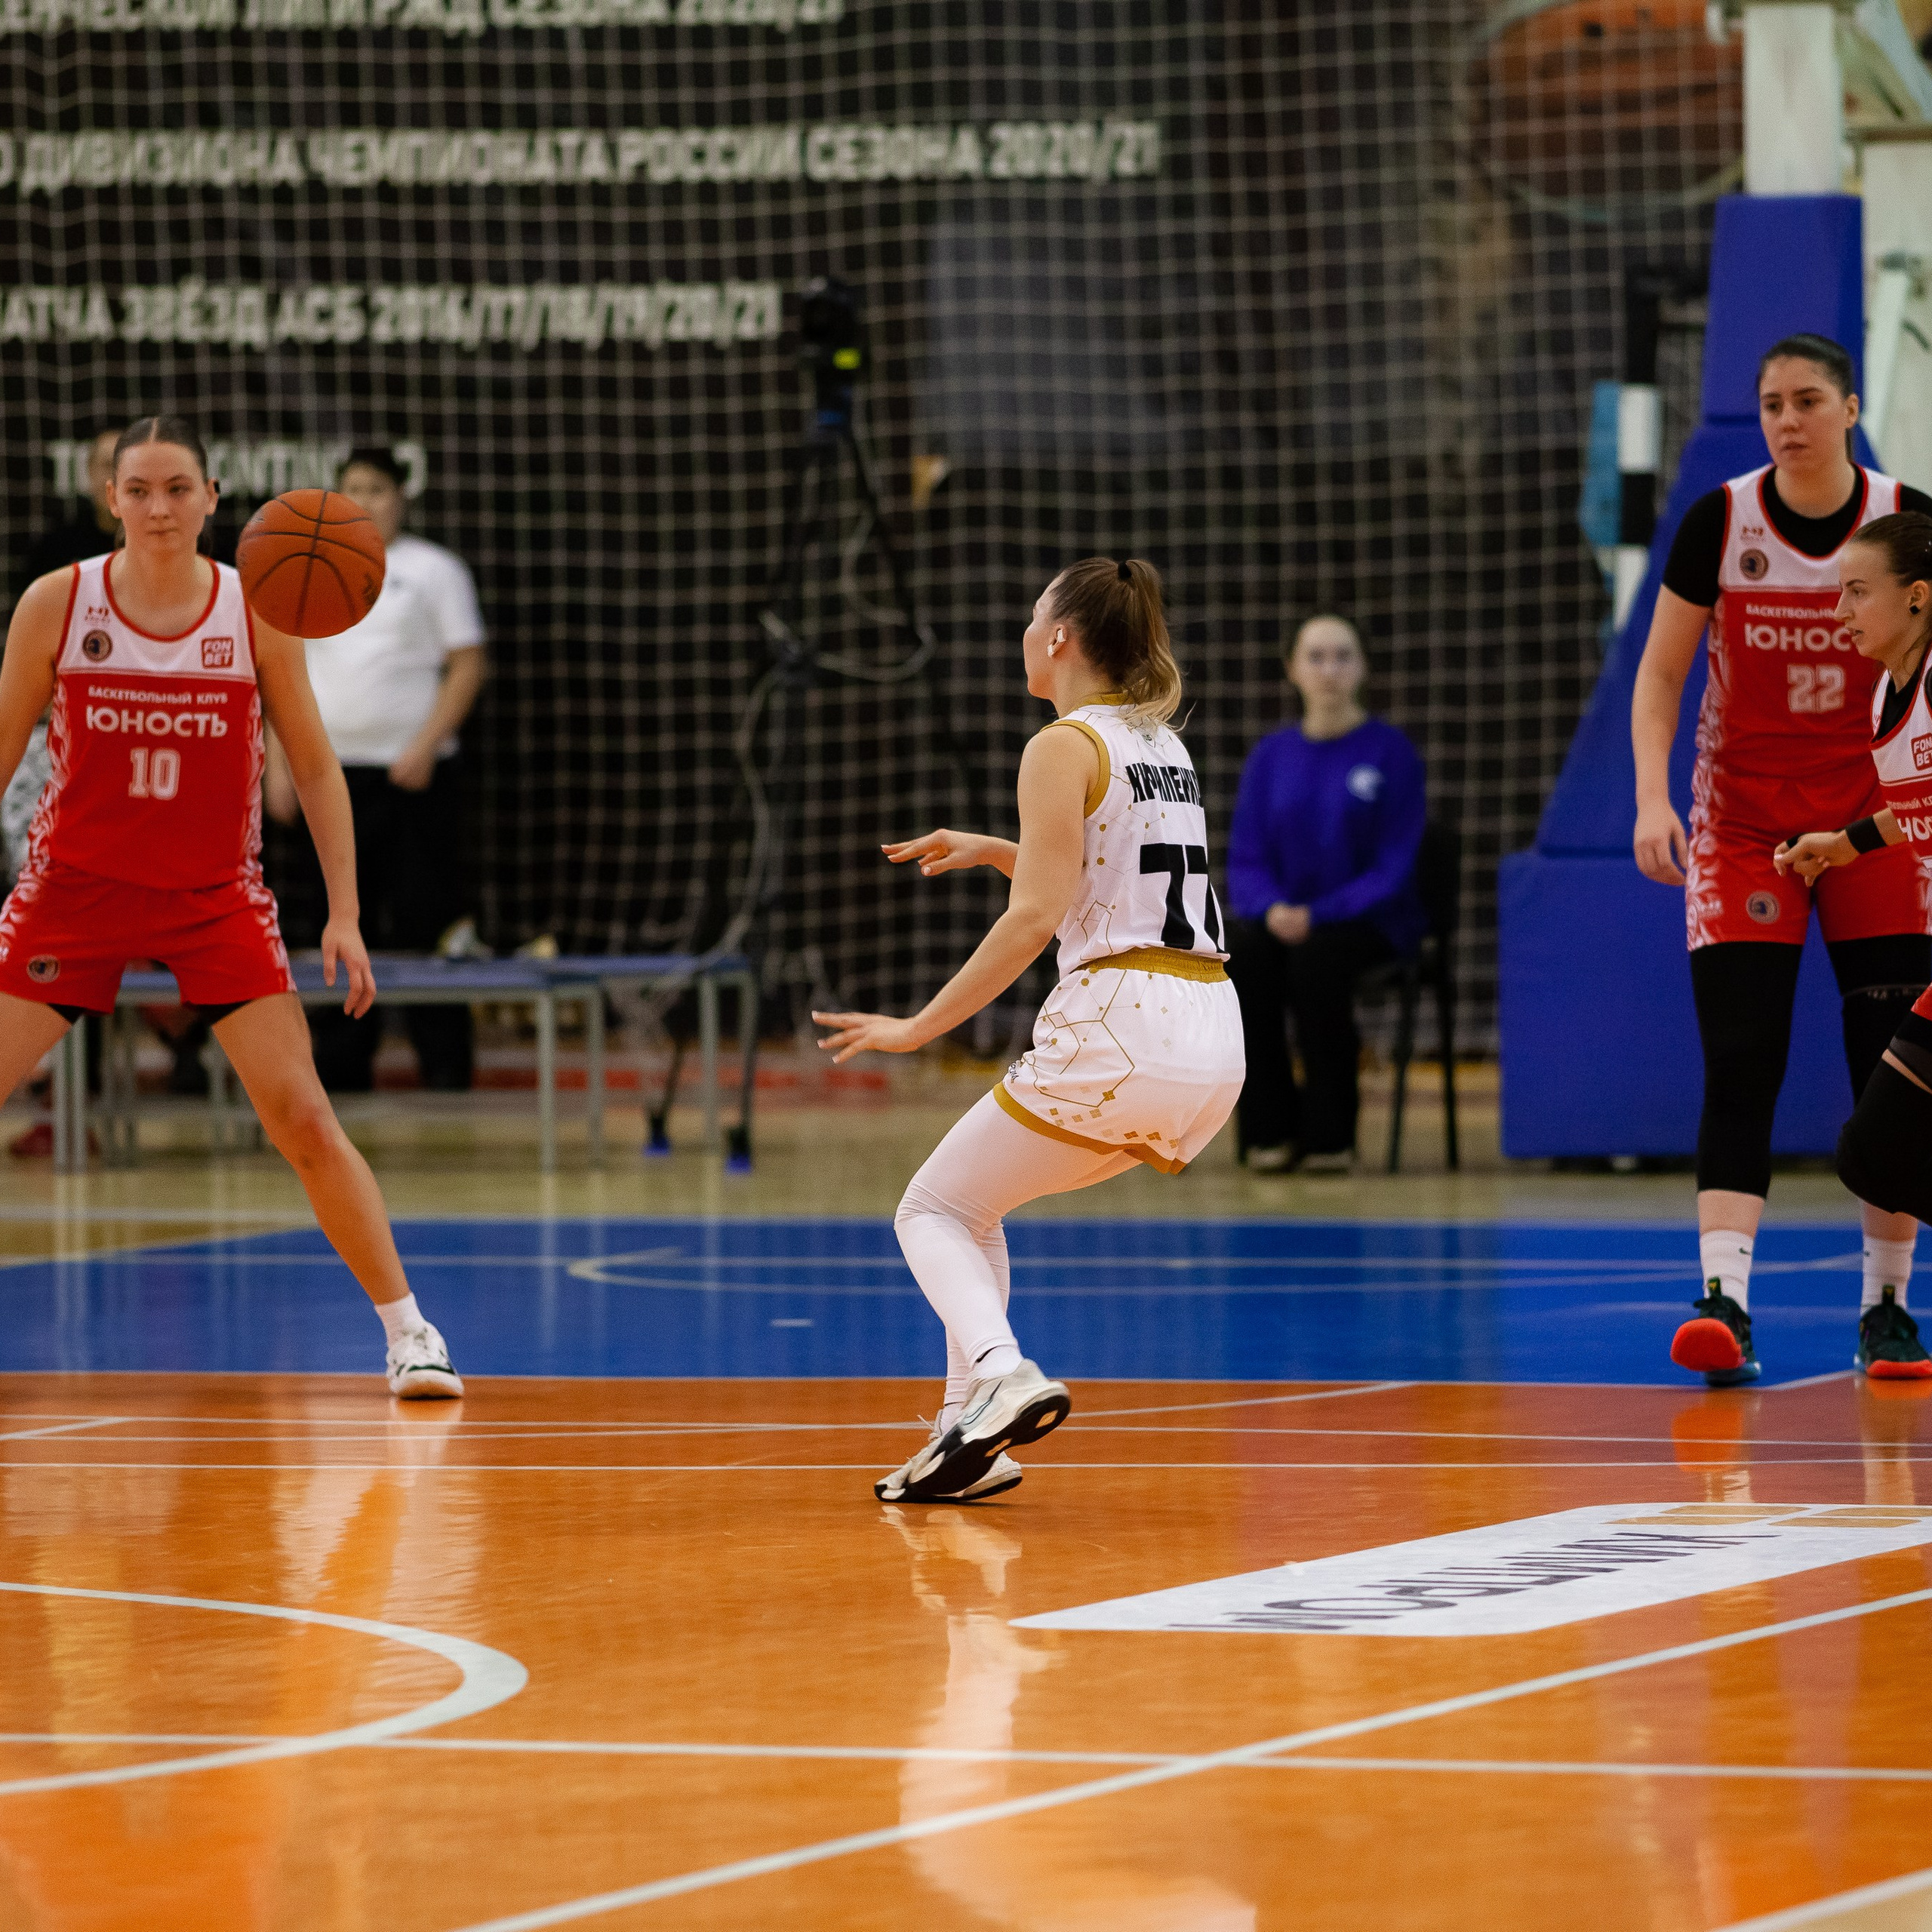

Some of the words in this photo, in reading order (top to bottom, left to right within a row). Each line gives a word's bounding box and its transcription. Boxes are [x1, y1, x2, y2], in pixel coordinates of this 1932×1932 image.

[21, 128, 306, 195] ДИВИЗИОНА
[308, 127, 609, 186] ЧЕМПИОНАТА
[616, 125, 803, 183] РОССИИ
[806, 122, 985, 181] СЕЗОНА
[989, 120, 1162, 184] 2020/21
[121, 274, 269, 350] ЗВЁЗД
[273, 285, 367, 344] АСБ
[1744, 623, 1851, 651] ЮНОС
[196, 692, 228, 704] КЛУБ
[1787, 663, 1844, 713] 22
[86, 705, 228, 737] ЮНОСТЬ
[128, 746, 181, 800] 10
[1140, 843, 1229, 954] 77
[1168, 1532, 1782, 1630] ХИМПРОМ
